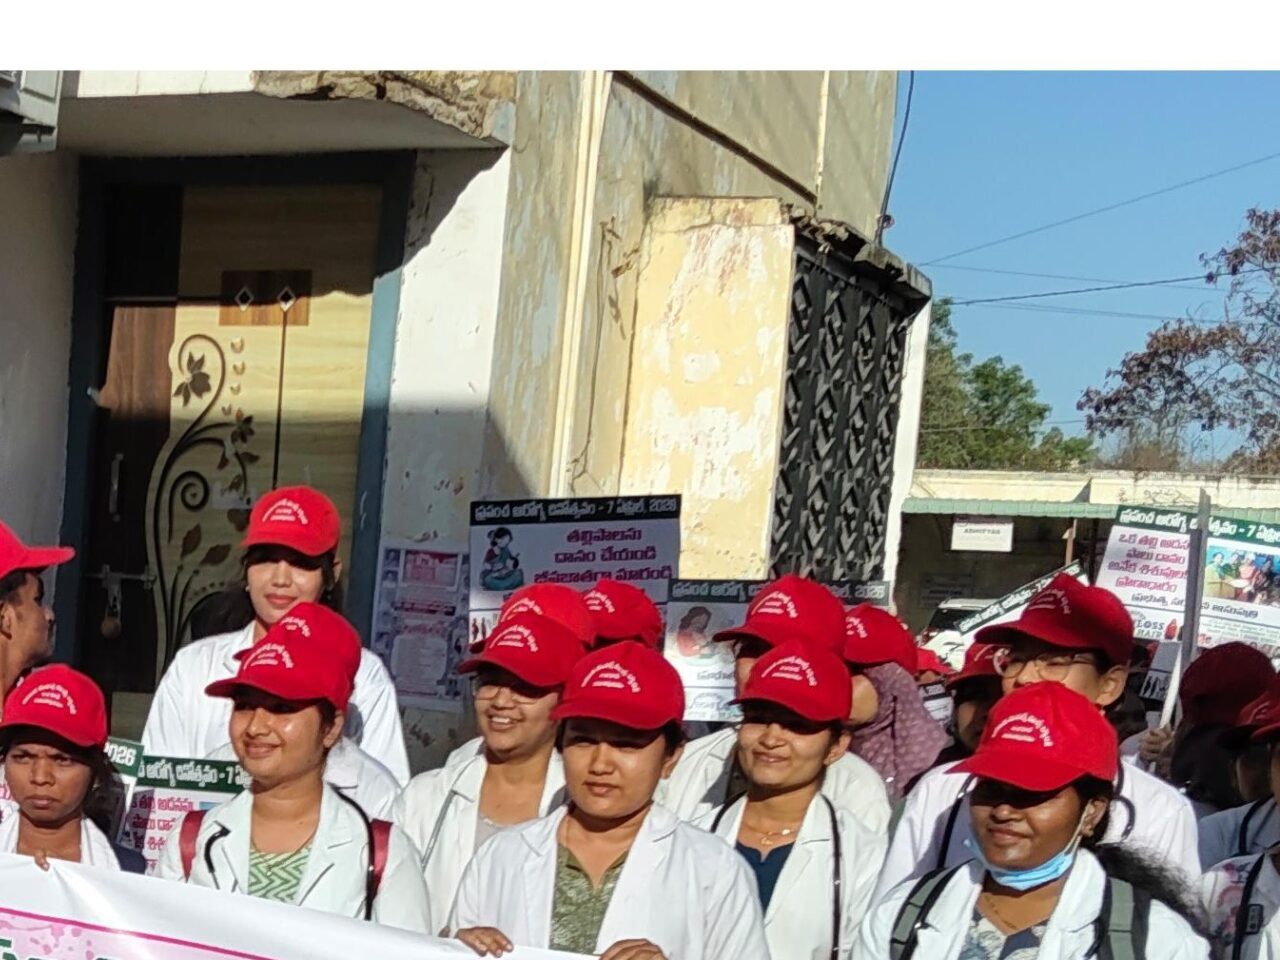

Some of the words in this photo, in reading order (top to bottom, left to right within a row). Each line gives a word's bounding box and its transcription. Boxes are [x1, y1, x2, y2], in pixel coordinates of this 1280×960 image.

[566, 526, 643, 546] తల్లిపాలను
[1246, 525, 1255, 539] 7
[553, 551, 596, 564] దానం
[599, 545, 657, 562] చేయండి
